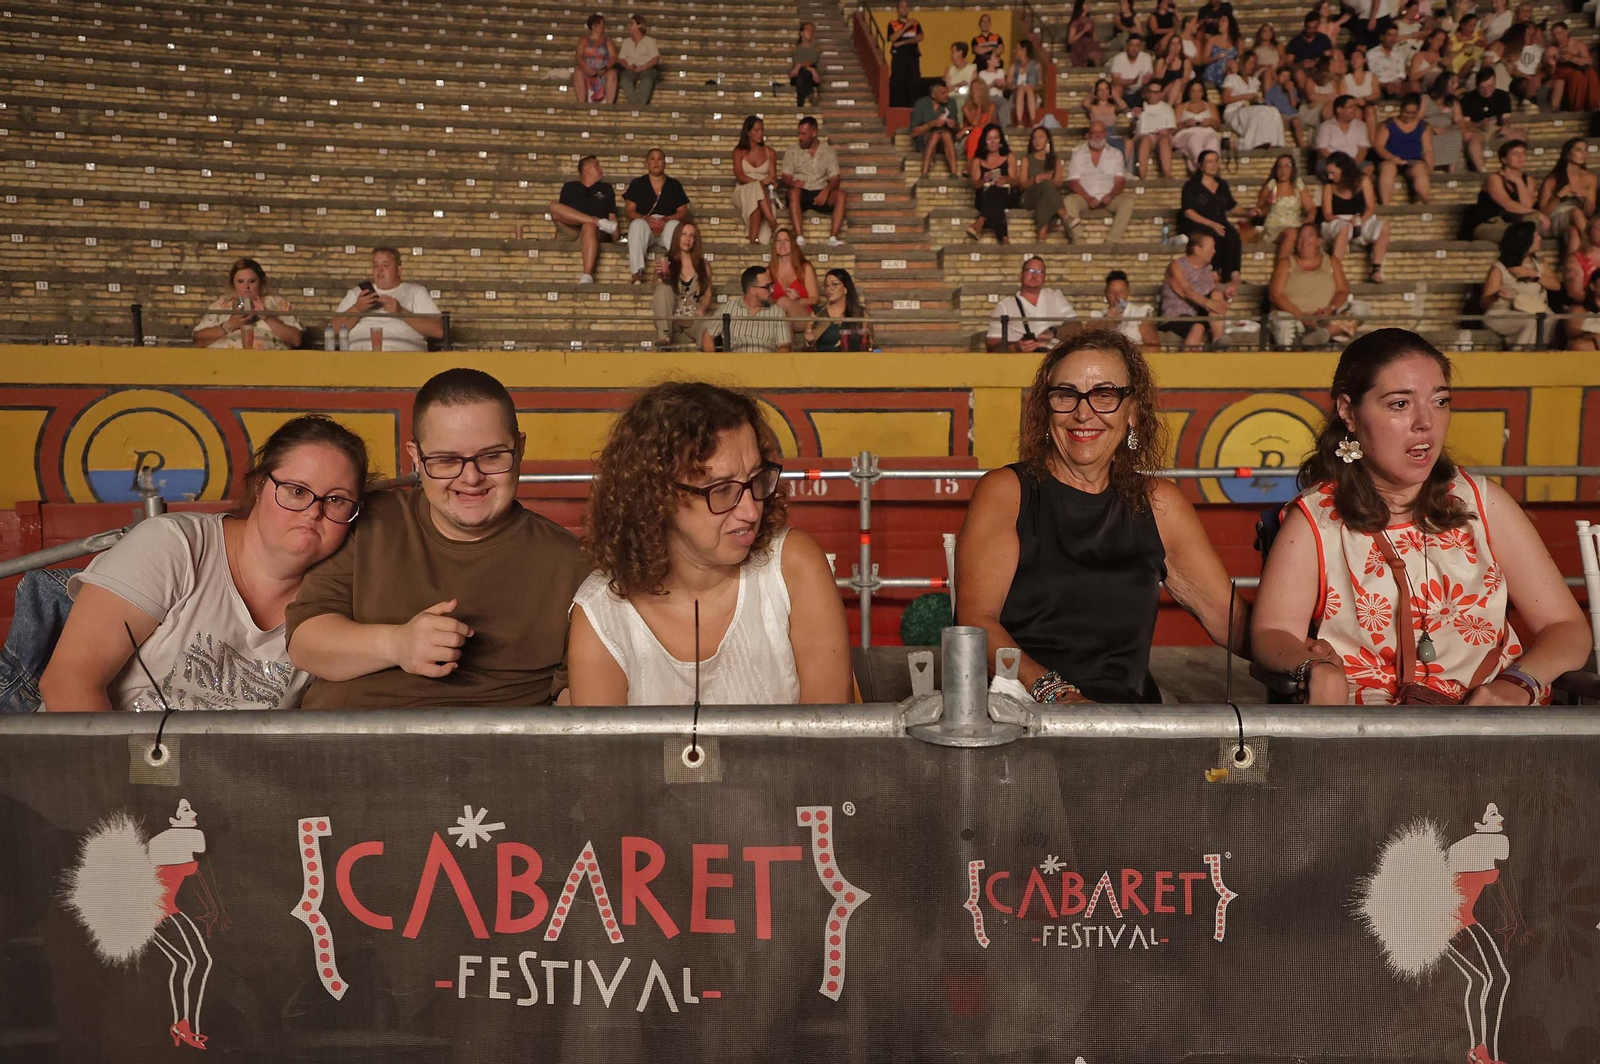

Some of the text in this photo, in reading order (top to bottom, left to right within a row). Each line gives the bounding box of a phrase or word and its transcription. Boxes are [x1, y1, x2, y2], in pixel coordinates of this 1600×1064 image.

[933, 478, 959, 494] 15
[335, 831, 803, 943] CABARET
[985, 866, 1207, 918] CABARET
